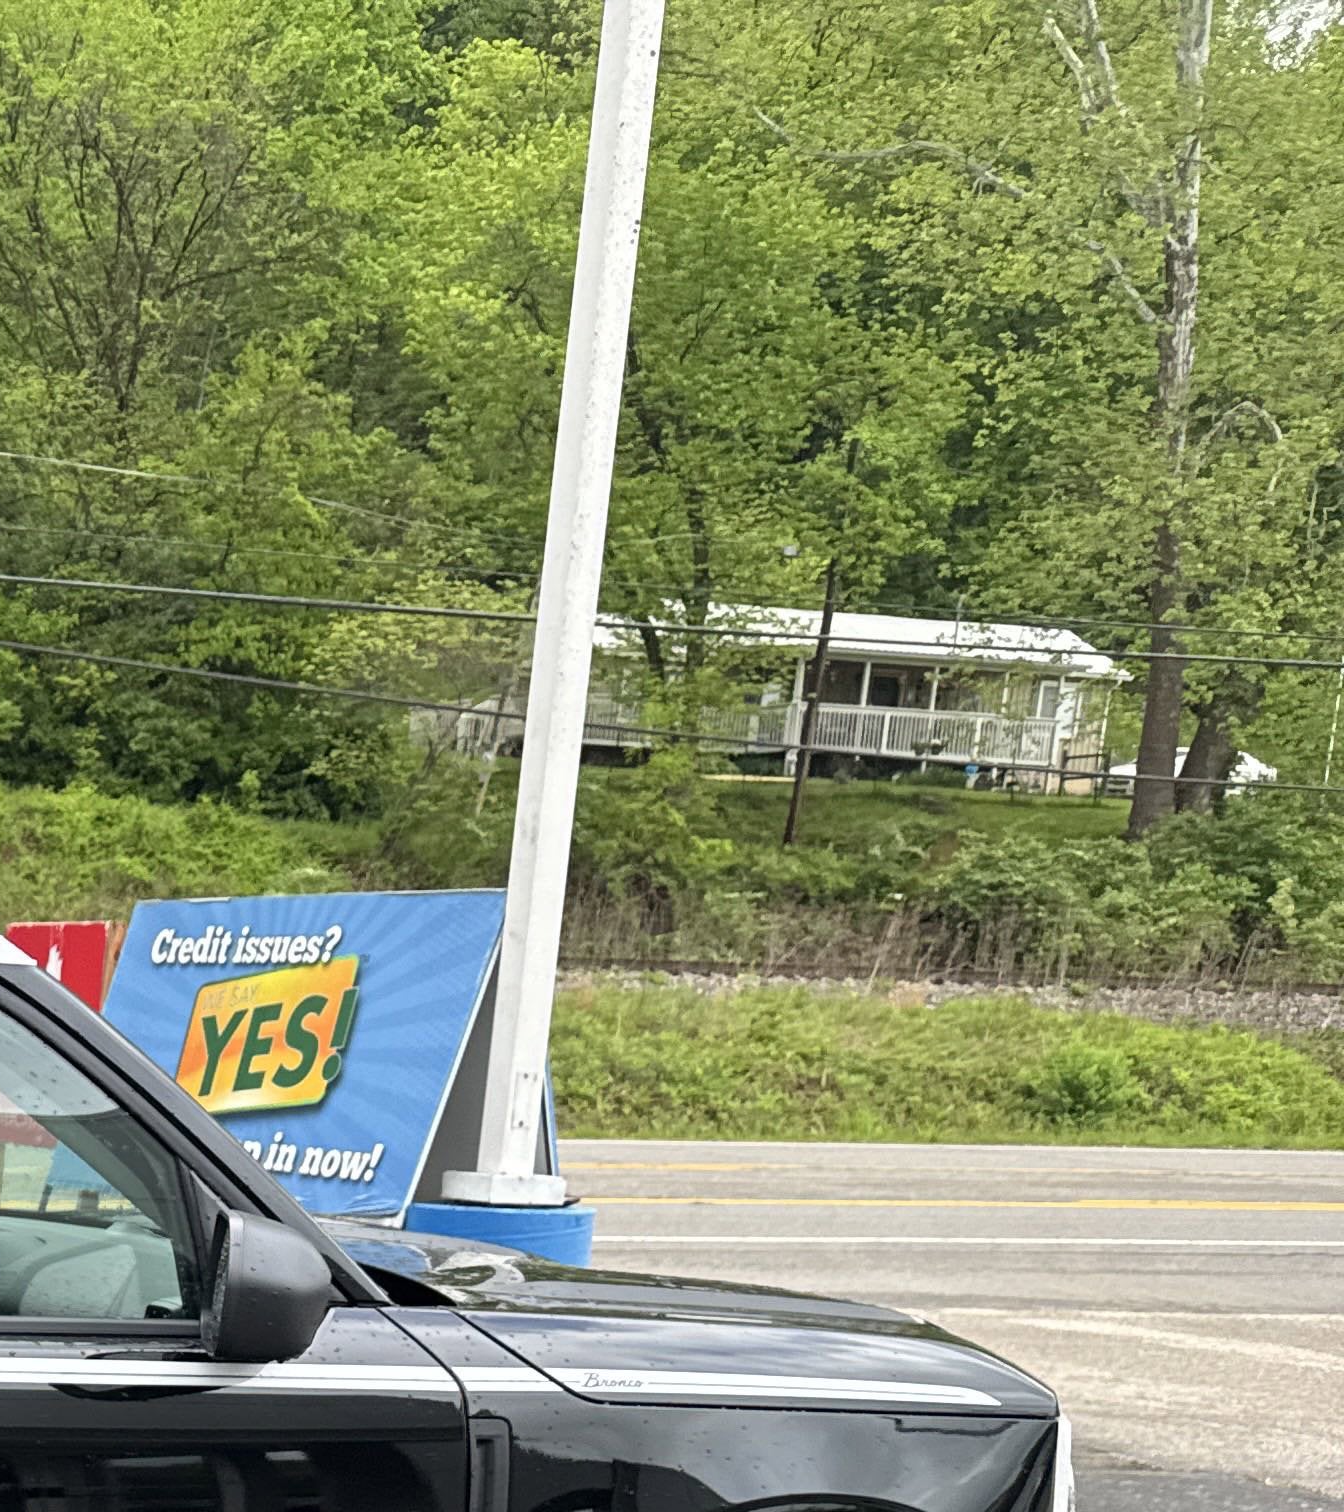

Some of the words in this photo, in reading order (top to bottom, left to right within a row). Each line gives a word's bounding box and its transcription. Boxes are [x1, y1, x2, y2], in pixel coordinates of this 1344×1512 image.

[151, 925, 232, 964] Credit
[232, 925, 342, 963] issues?
[198, 986, 359, 1096] YES!
[263, 1131, 297, 1173] in
[298, 1143, 384, 1182] now!
[582, 1372, 644, 1388] Bronco
